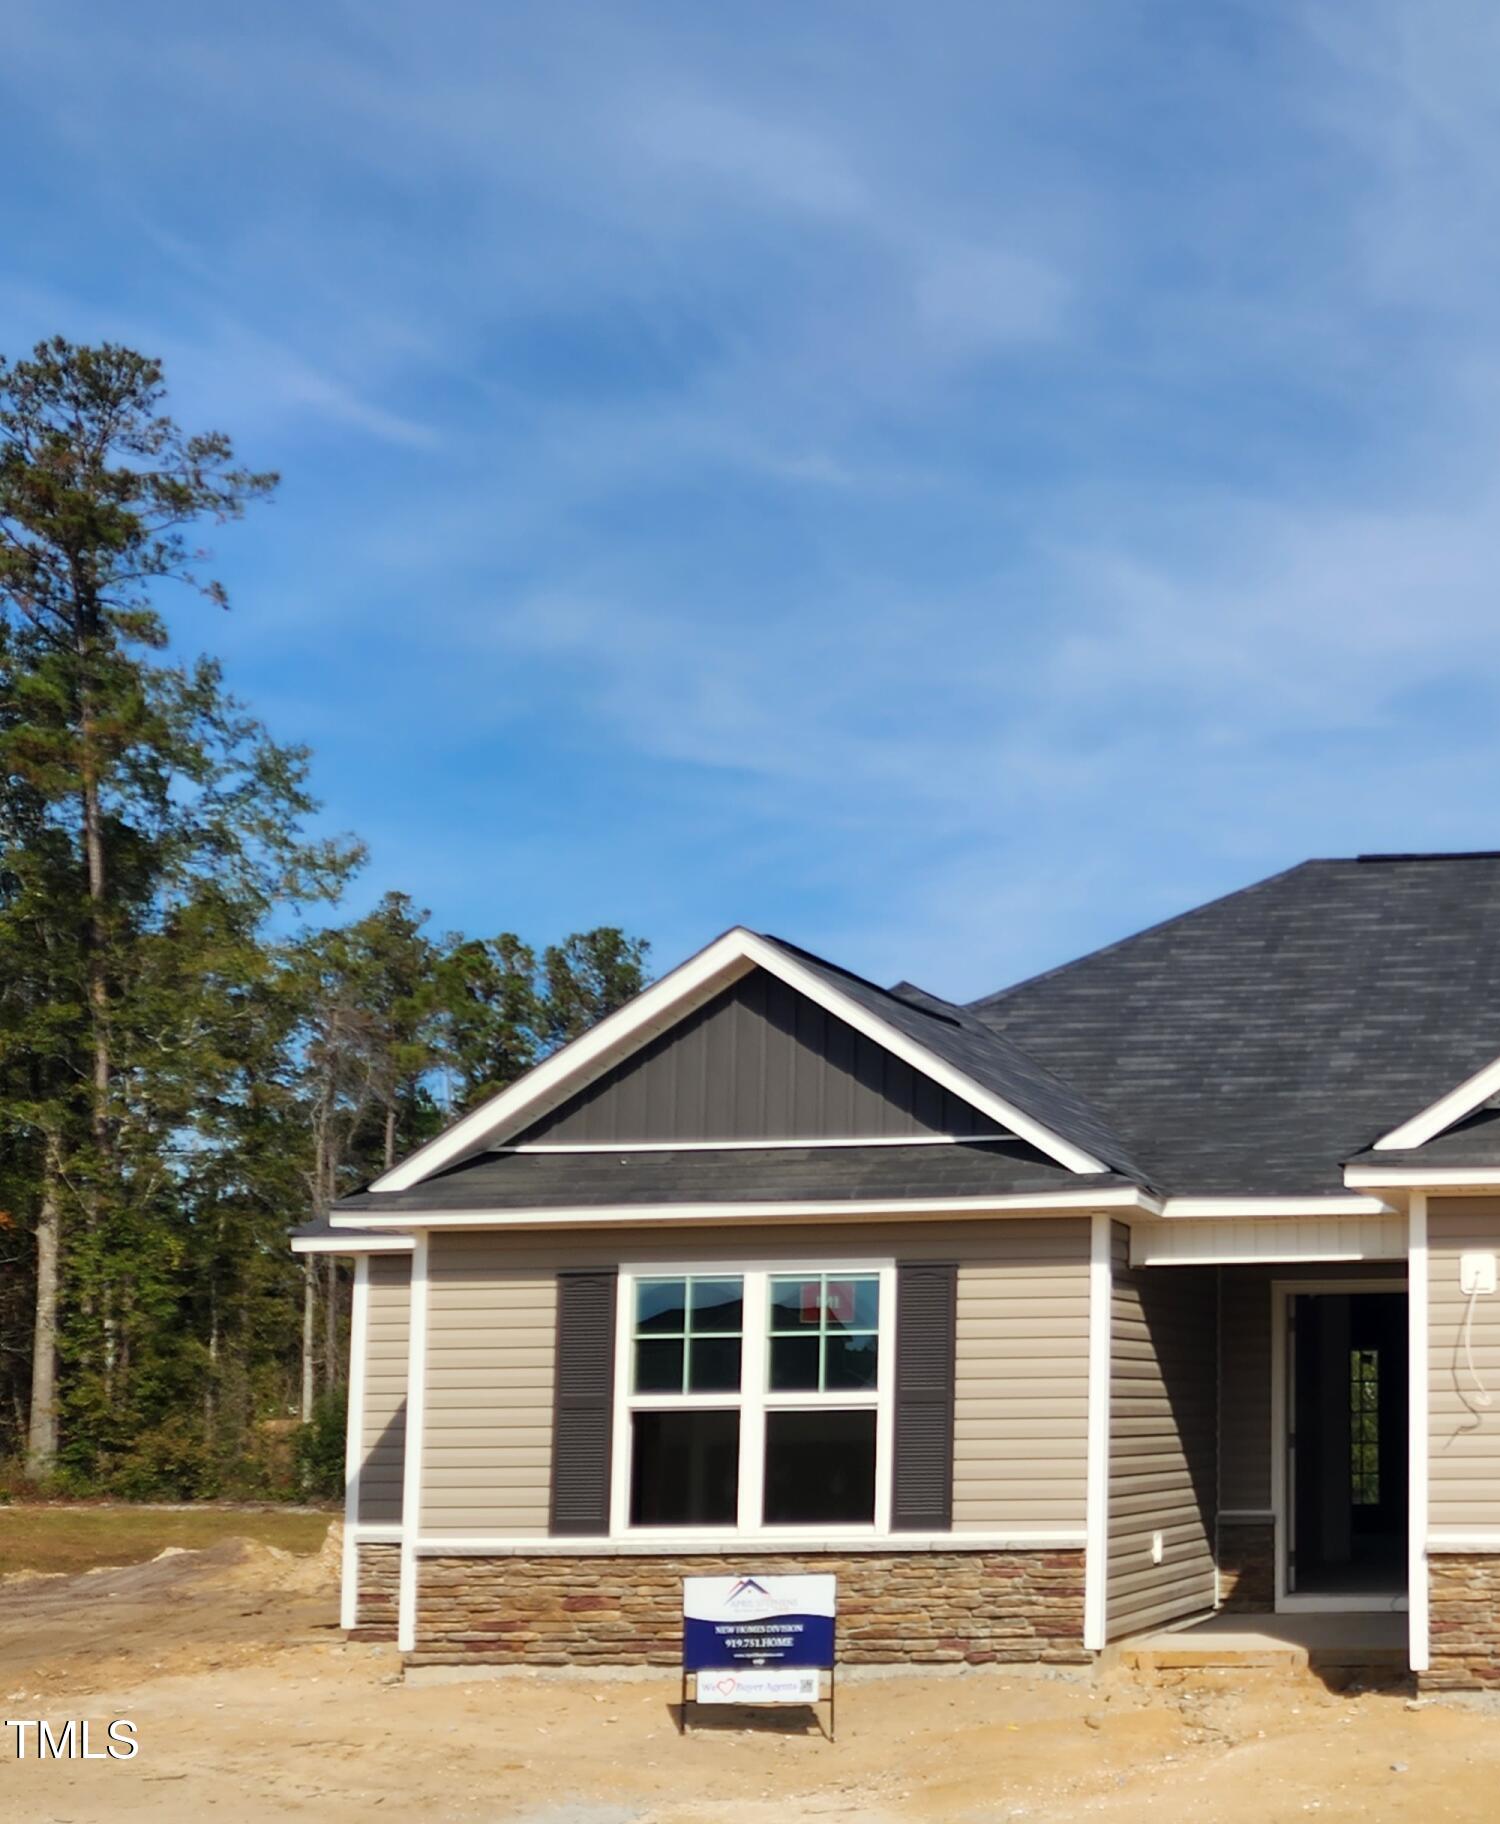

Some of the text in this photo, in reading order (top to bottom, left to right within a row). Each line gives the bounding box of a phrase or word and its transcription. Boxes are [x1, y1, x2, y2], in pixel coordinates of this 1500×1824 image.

[715, 1624, 804, 1634] NEW HOMES DIVISION
